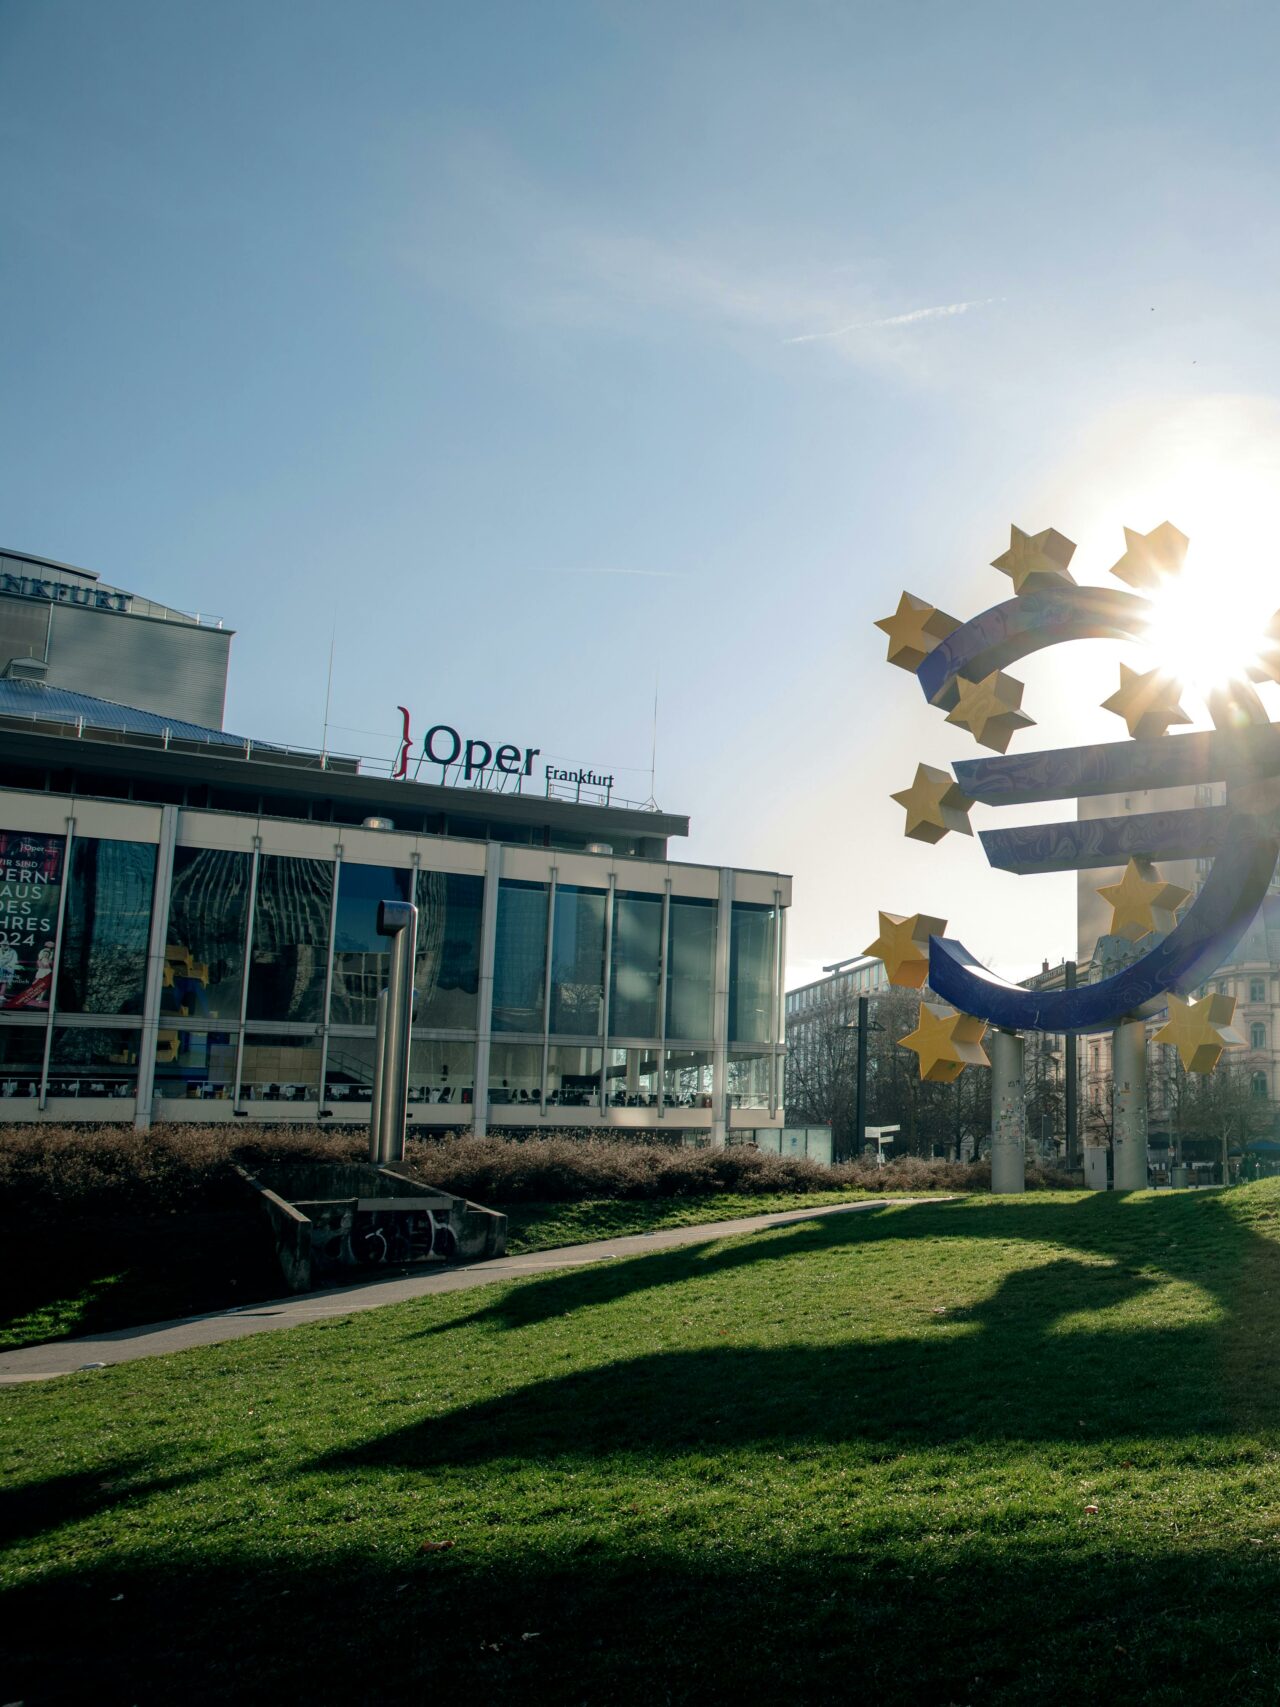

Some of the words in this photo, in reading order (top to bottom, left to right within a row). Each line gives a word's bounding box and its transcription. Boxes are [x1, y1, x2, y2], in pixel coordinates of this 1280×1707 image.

[424, 724, 541, 780] Oper
[545, 765, 615, 787] Frankfurt
[15, 859, 38, 868] SIND
